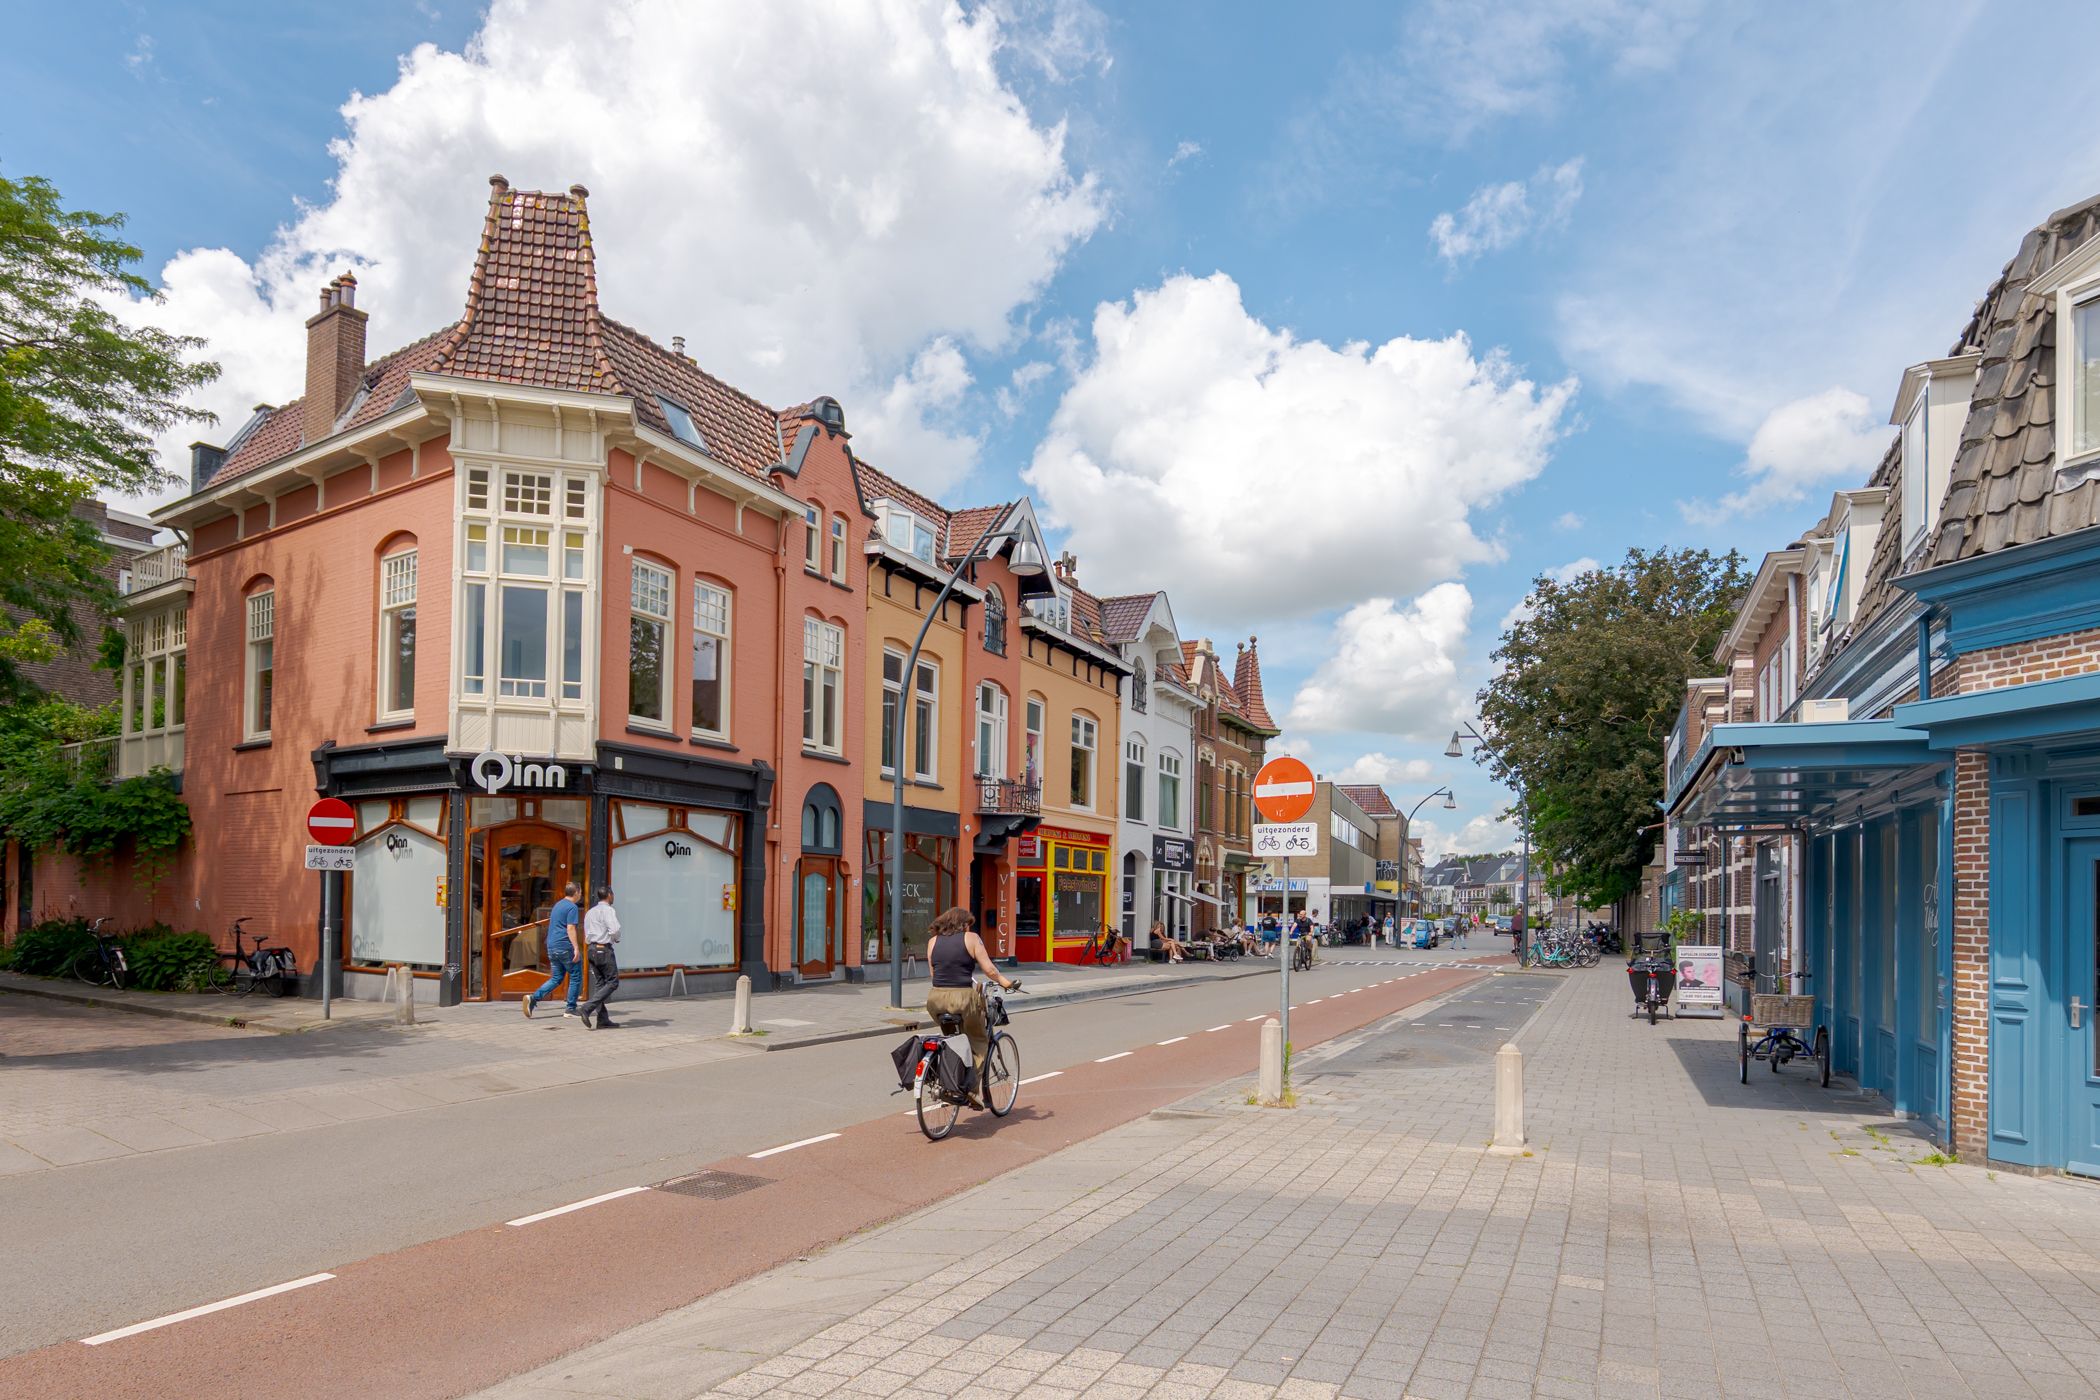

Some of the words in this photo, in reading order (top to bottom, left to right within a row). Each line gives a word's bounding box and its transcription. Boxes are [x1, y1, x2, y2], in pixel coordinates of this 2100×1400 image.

[471, 750, 566, 795] Qinn
[1257, 826, 1311, 835] uitgezonderd
[308, 848, 355, 856] uitgezonderd
[387, 834, 408, 853] Qinn
[665, 840, 692, 859] Qinn
[886, 880, 921, 898] VECK
